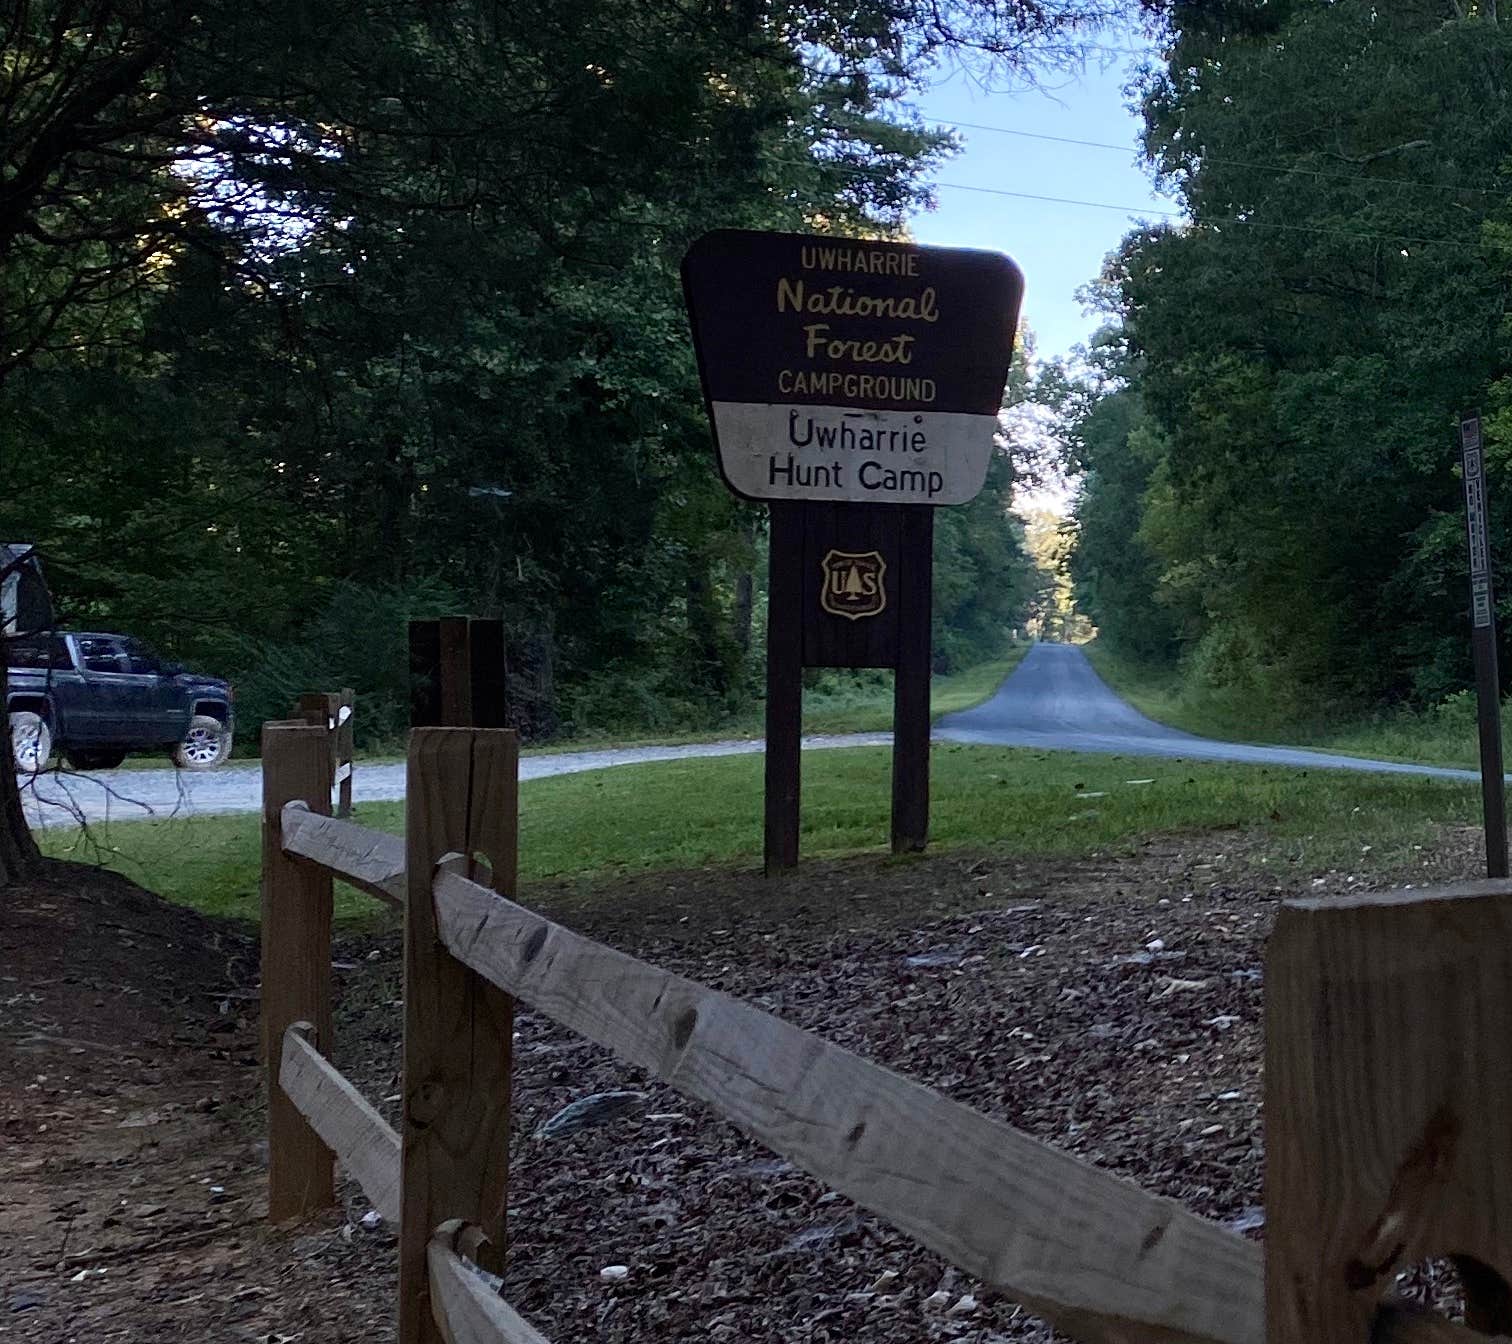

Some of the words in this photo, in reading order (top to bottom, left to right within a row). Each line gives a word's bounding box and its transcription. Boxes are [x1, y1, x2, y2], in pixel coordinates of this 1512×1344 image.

[800, 245, 920, 278] UWHARRIE
[776, 277, 939, 322] National
[803, 323, 915, 364] Forest
[778, 369, 936, 402] CAMPGROUND
[789, 417, 926, 452] Uwharrie
[769, 455, 842, 487] Hunt
[859, 461, 943, 498] Camp
